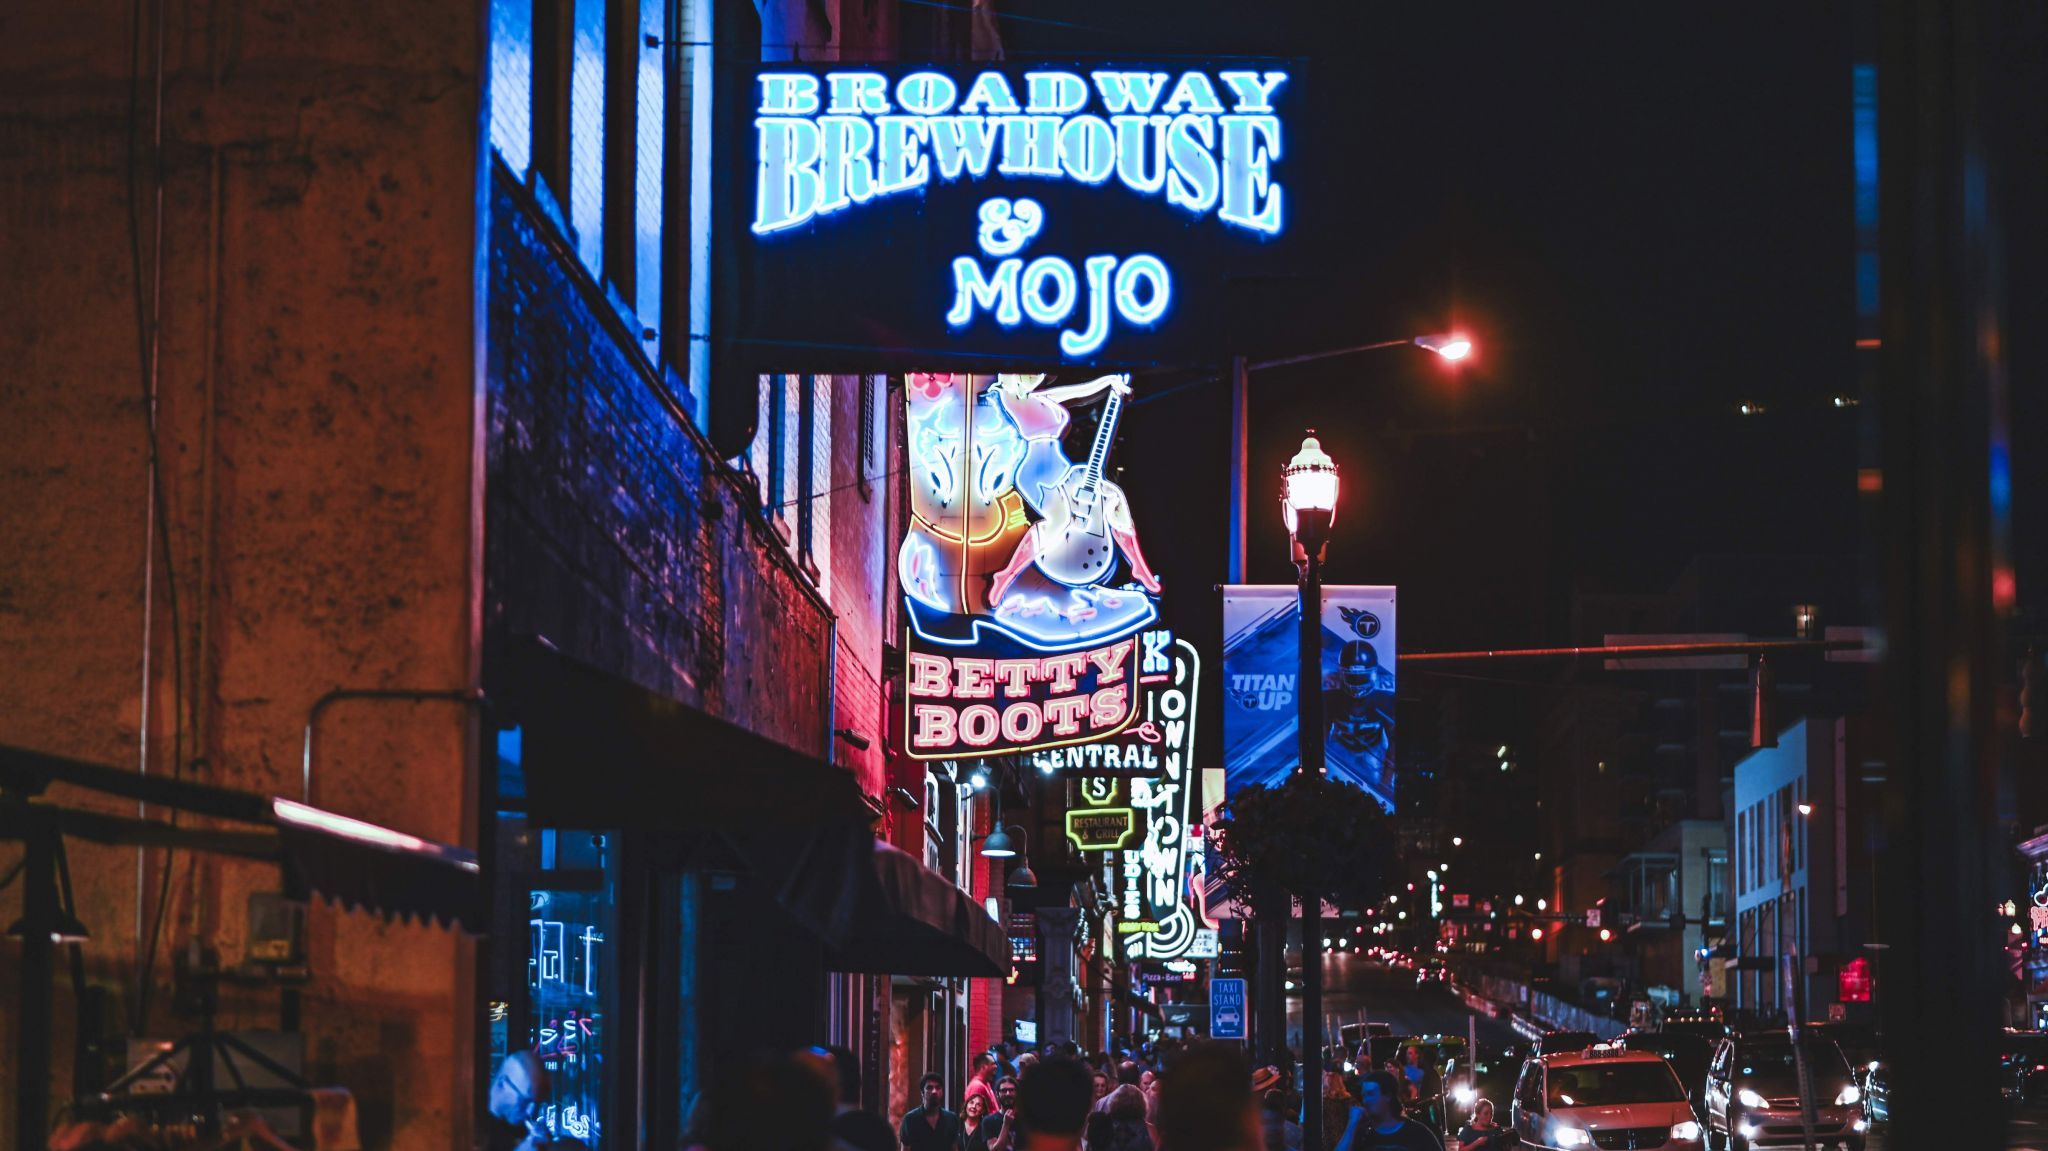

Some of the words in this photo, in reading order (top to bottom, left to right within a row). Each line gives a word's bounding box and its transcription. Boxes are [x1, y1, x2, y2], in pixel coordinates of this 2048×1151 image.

[756, 71, 1287, 115] BROADWAY
[752, 113, 1283, 234] BREWHOUSE
[977, 197, 1043, 255] &
[946, 254, 1172, 356] MOJO
[909, 638, 1135, 698] BETTY
[1231, 674, 1295, 692] TITAN
[1258, 692, 1292, 711] UP
[913, 682, 1128, 748] BOOTS
[1074, 816, 1128, 828] RESTAURANT
[1082, 830, 1089, 840] &
[1095, 828, 1120, 839] GRILL
[1142, 973, 1161, 981] Pizza
[1219, 982, 1238, 994] TAXI
[1213, 995, 1241, 1006] STAND
